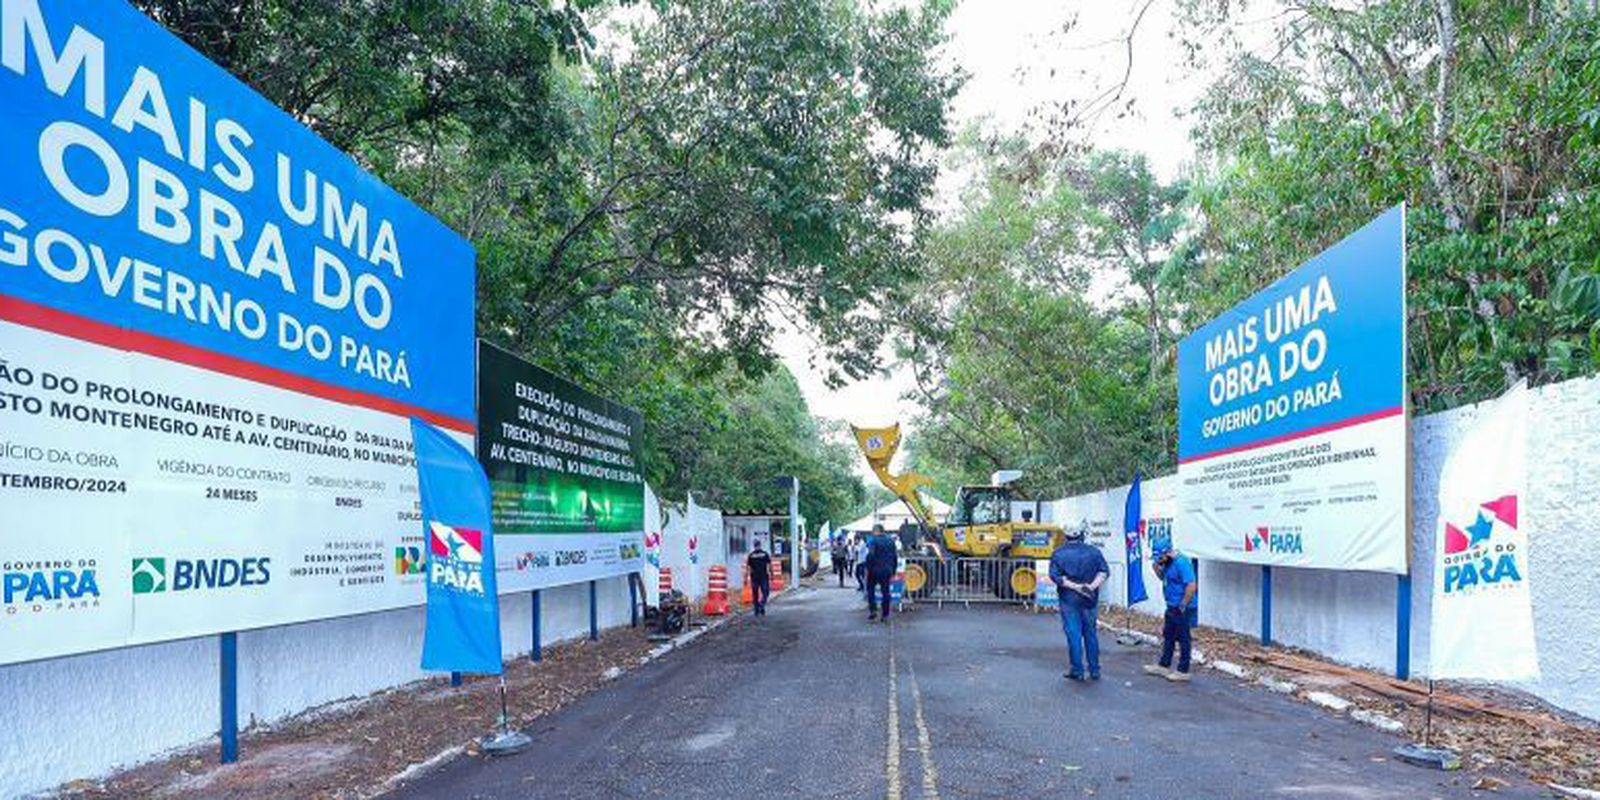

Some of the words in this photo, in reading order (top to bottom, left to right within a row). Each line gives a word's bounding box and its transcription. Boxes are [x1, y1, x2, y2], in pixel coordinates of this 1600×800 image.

[2, 0, 254, 192] MAIS
[277, 152, 404, 279] UMA
[38, 120, 297, 294] OBRA
[313, 246, 393, 331] DO
[0, 208, 268, 341] GOVERNO
[278, 311, 333, 361] DO
[340, 335, 412, 389] PARÁ
[1205, 316, 1258, 373] MAIS
[1264, 275, 1337, 343] UMA
[1209, 354, 1273, 407] OBRA
[1280, 328, 1328, 382] DO
[42, 372, 78, 395] DO
[86, 381, 254, 424] PROLONGAMENTO
[257, 414, 266, 428] E
[271, 415, 347, 443] DUPLICAÇÃO
[355, 431, 370, 445] DA
[515, 382, 562, 412] EXECUÇÃO
[563, 402, 576, 417] DO
[1202, 405, 1262, 438] GOVERNO
[1265, 396, 1289, 421] DO
[1293, 368, 1342, 413] PARÁ
[48, 449, 72, 464] DA
[76, 452, 119, 469] OBRA
[51, 401, 199, 436] MONTENEGRO
[202, 424, 231, 442] ATÉ
[235, 430, 246, 445] A
[248, 432, 271, 448] AV.
[354, 448, 370, 461] NO
[0, 473, 126, 493] TEMBRO/2024
[206, 487, 220, 499] 24
[223, 488, 258, 502] MESES
[216, 465, 235, 478] DO
[4, 561, 72, 571] GOVERNO
[79, 559, 97, 568] DO
[173, 557, 271, 591] BNDES
